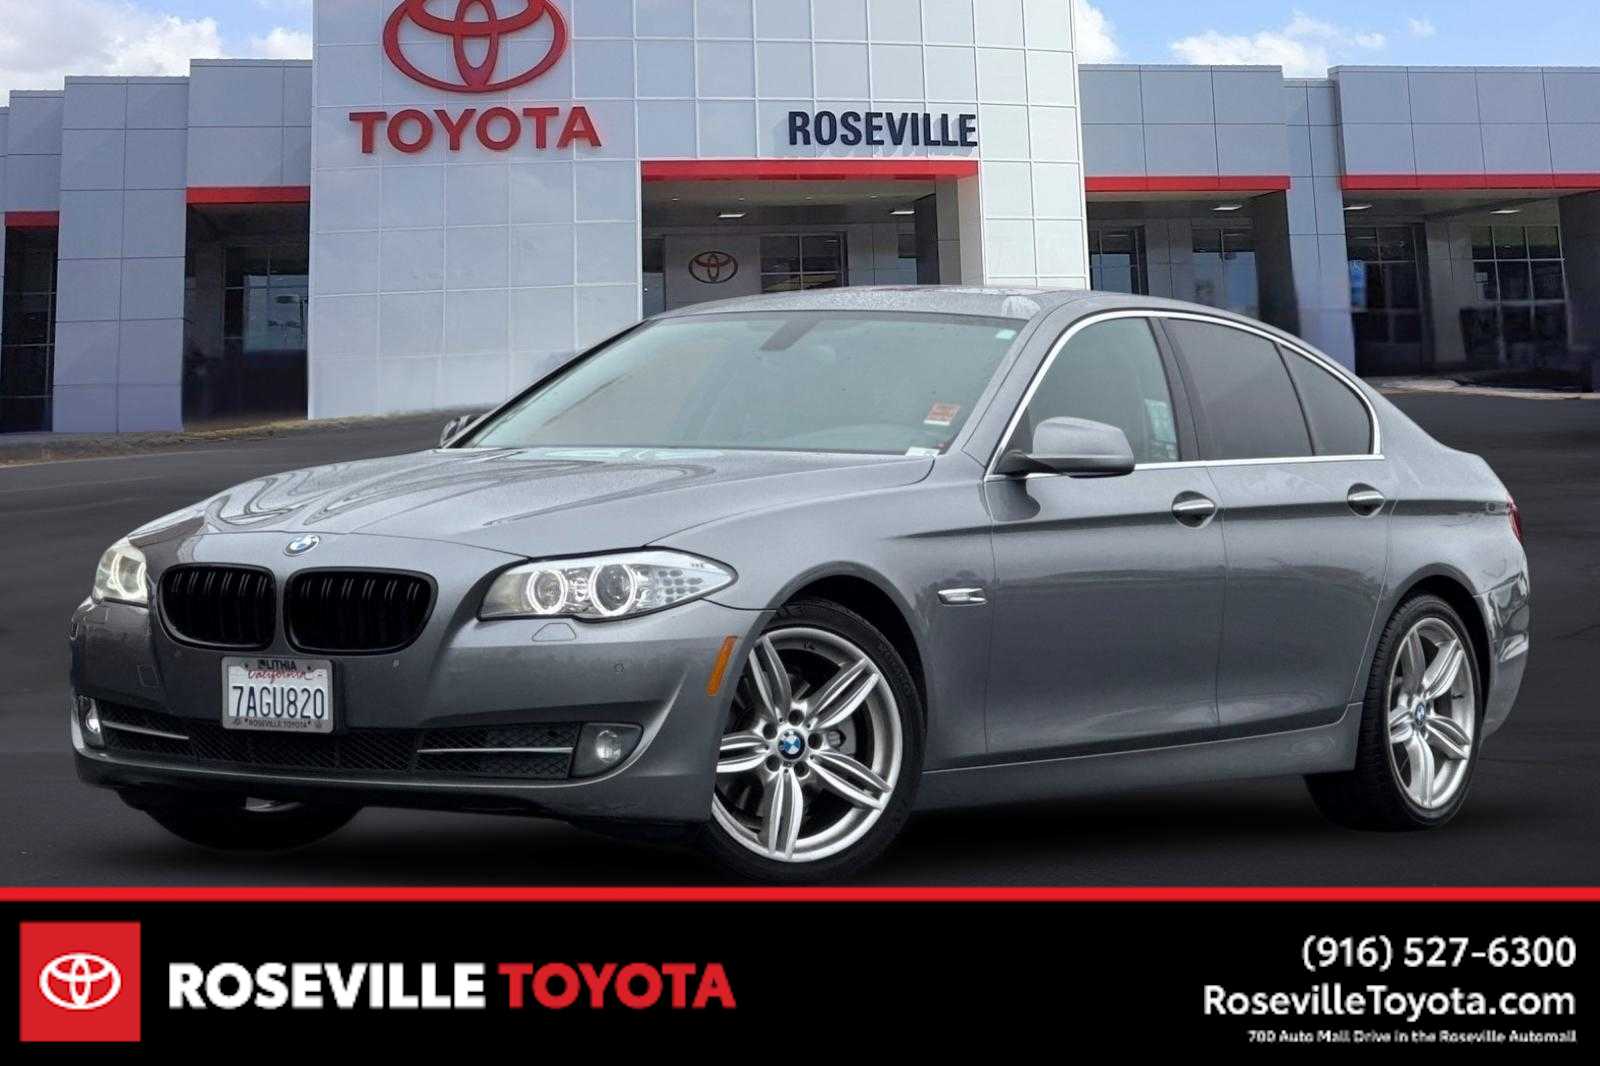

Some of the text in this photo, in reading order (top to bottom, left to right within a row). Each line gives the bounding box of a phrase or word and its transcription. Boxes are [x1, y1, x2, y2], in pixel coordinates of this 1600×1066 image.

[350, 106, 602, 154] TOYOTA
[789, 111, 978, 147] ROSEVILLE
[267, 659, 297, 671] LITHIA
[232, 686, 325, 719] 7AGU820
